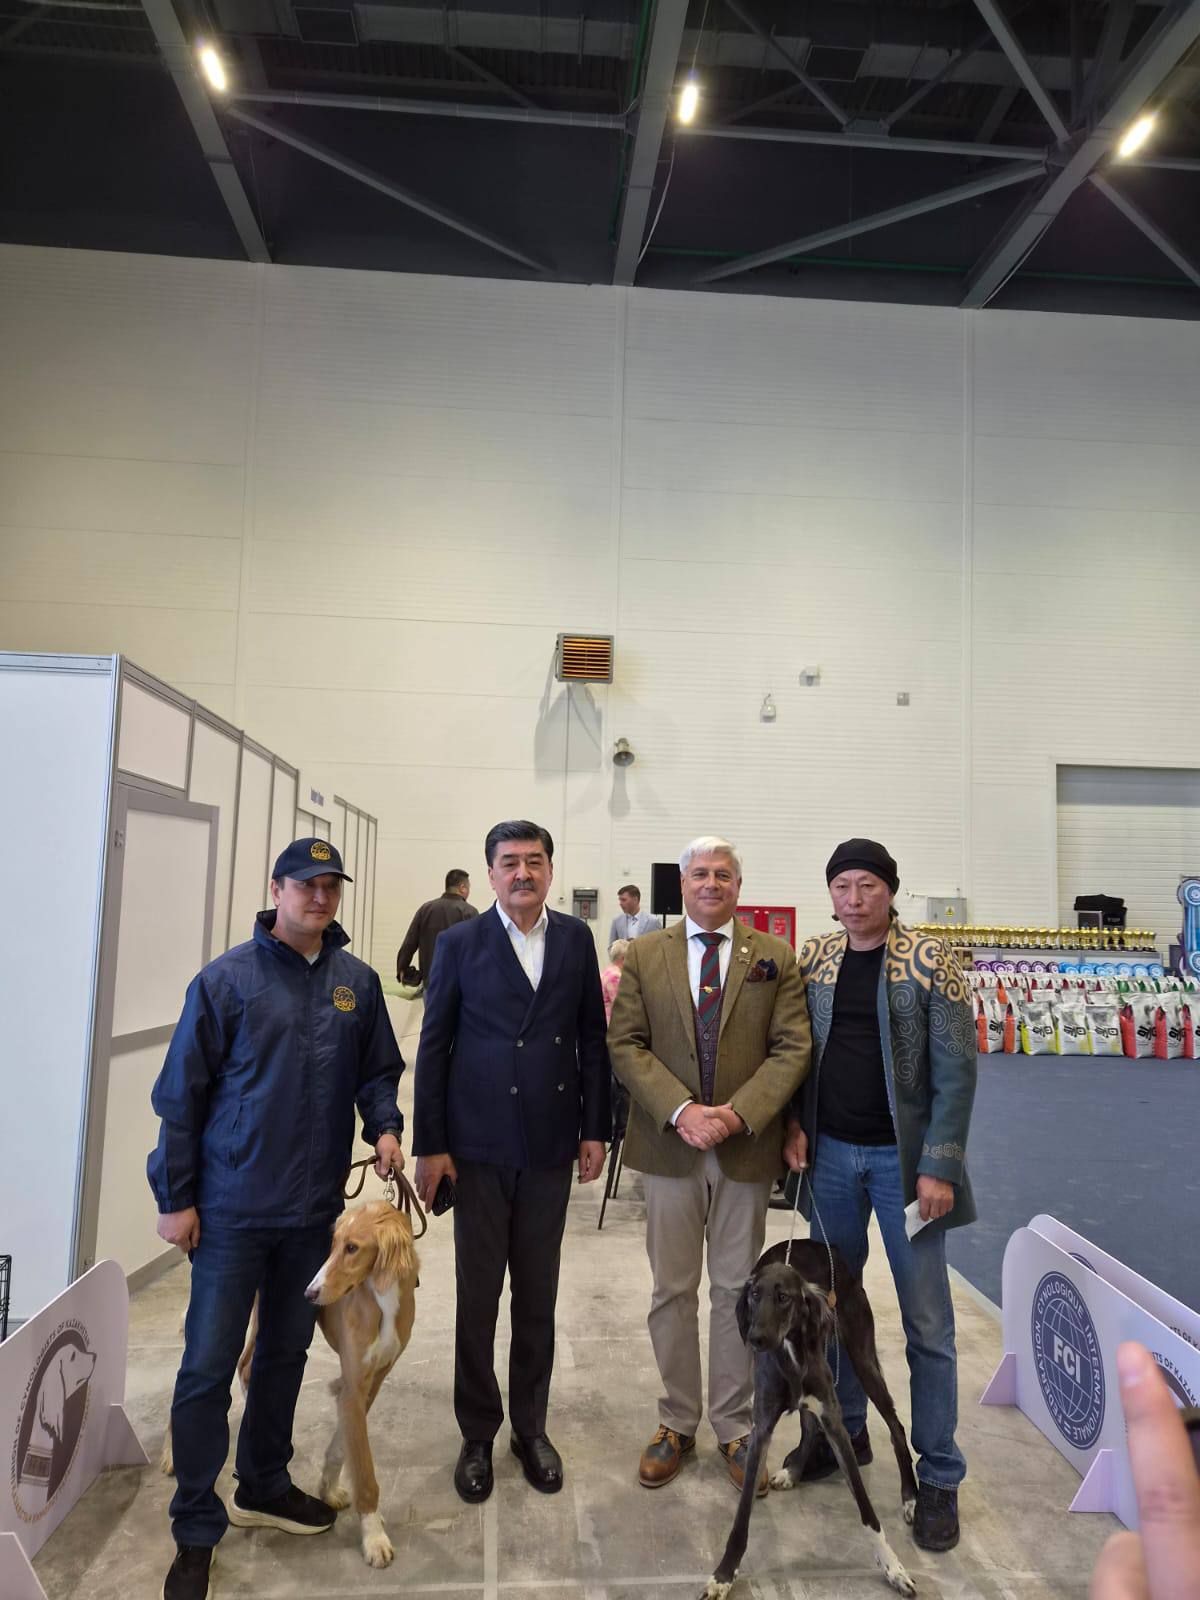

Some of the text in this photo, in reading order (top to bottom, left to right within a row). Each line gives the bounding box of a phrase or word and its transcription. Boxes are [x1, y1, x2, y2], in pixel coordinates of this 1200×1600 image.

[1035, 1281, 1101, 1440] FEDERATION CYNOLOGIQUE INTERNATIONALE
[1054, 1334, 1080, 1384] FCI
[1164, 1357, 1174, 1369] OF
